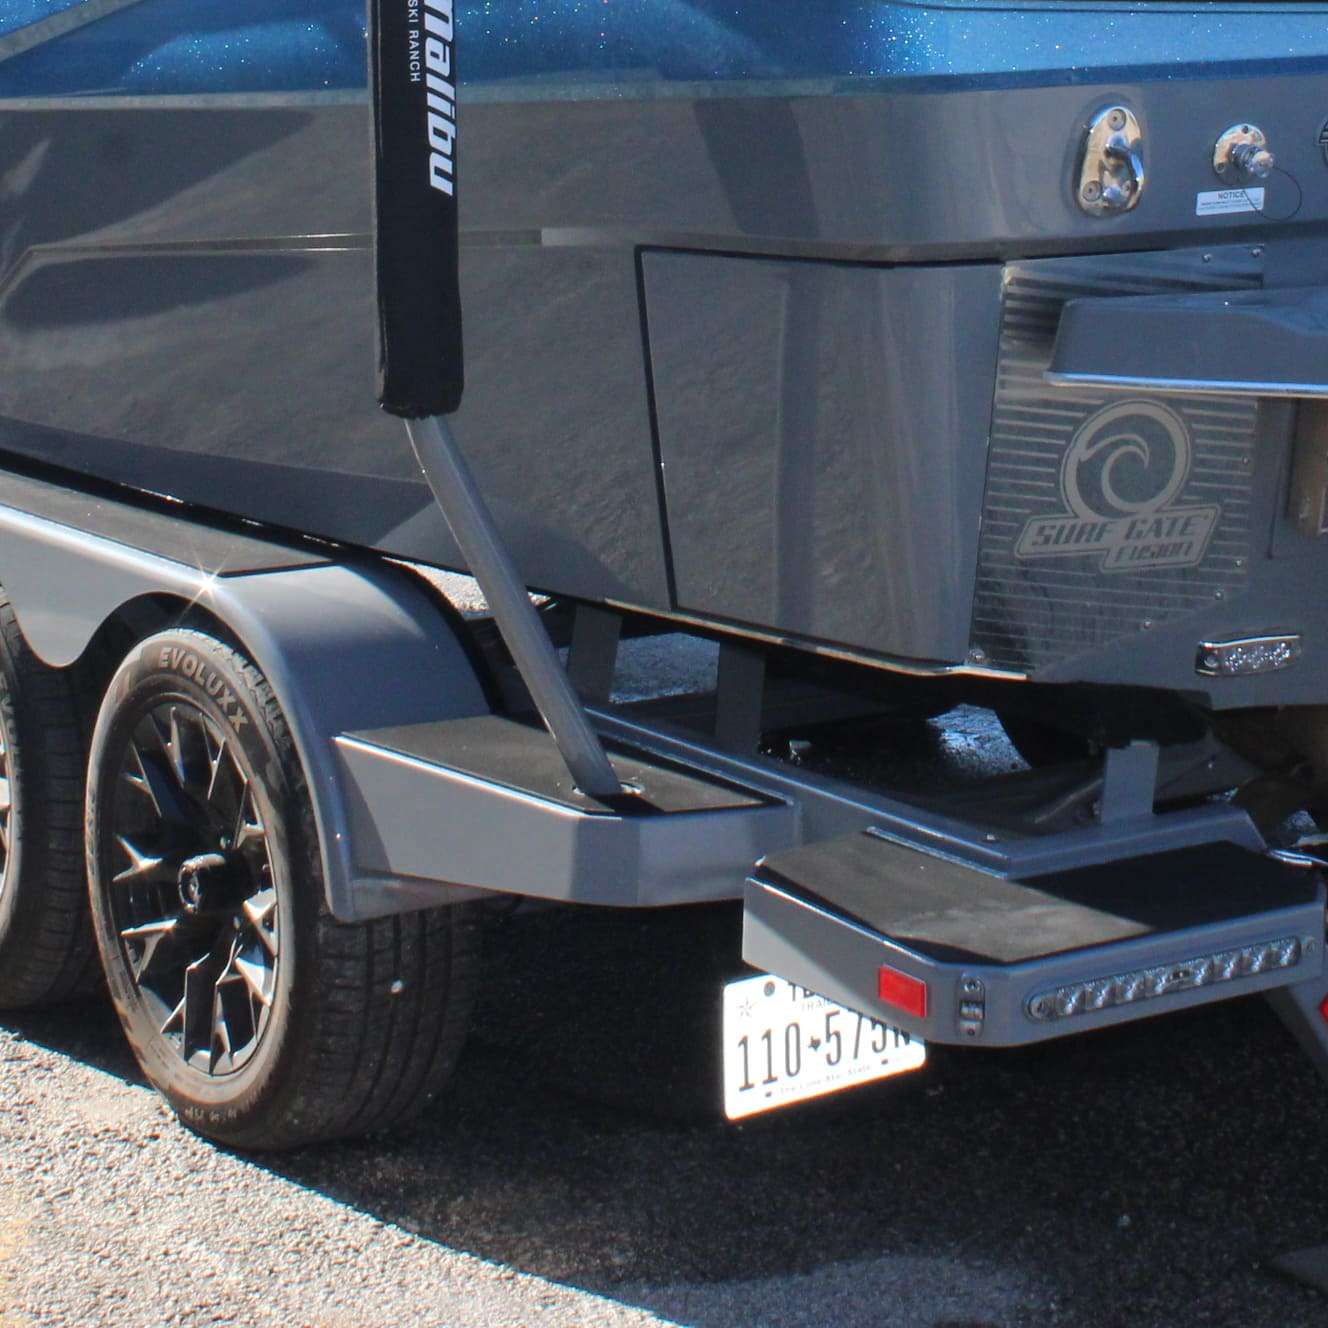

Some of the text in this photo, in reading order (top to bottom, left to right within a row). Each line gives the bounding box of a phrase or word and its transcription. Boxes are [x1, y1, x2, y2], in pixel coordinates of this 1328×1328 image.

[408, 0, 419, 24] SKI
[409, 29, 421, 83] RANCH
[1217, 190, 1246, 201] NOTICE
[1031, 514, 1201, 547] SURF GATE
[159, 648, 249, 733] EVOLUXX
